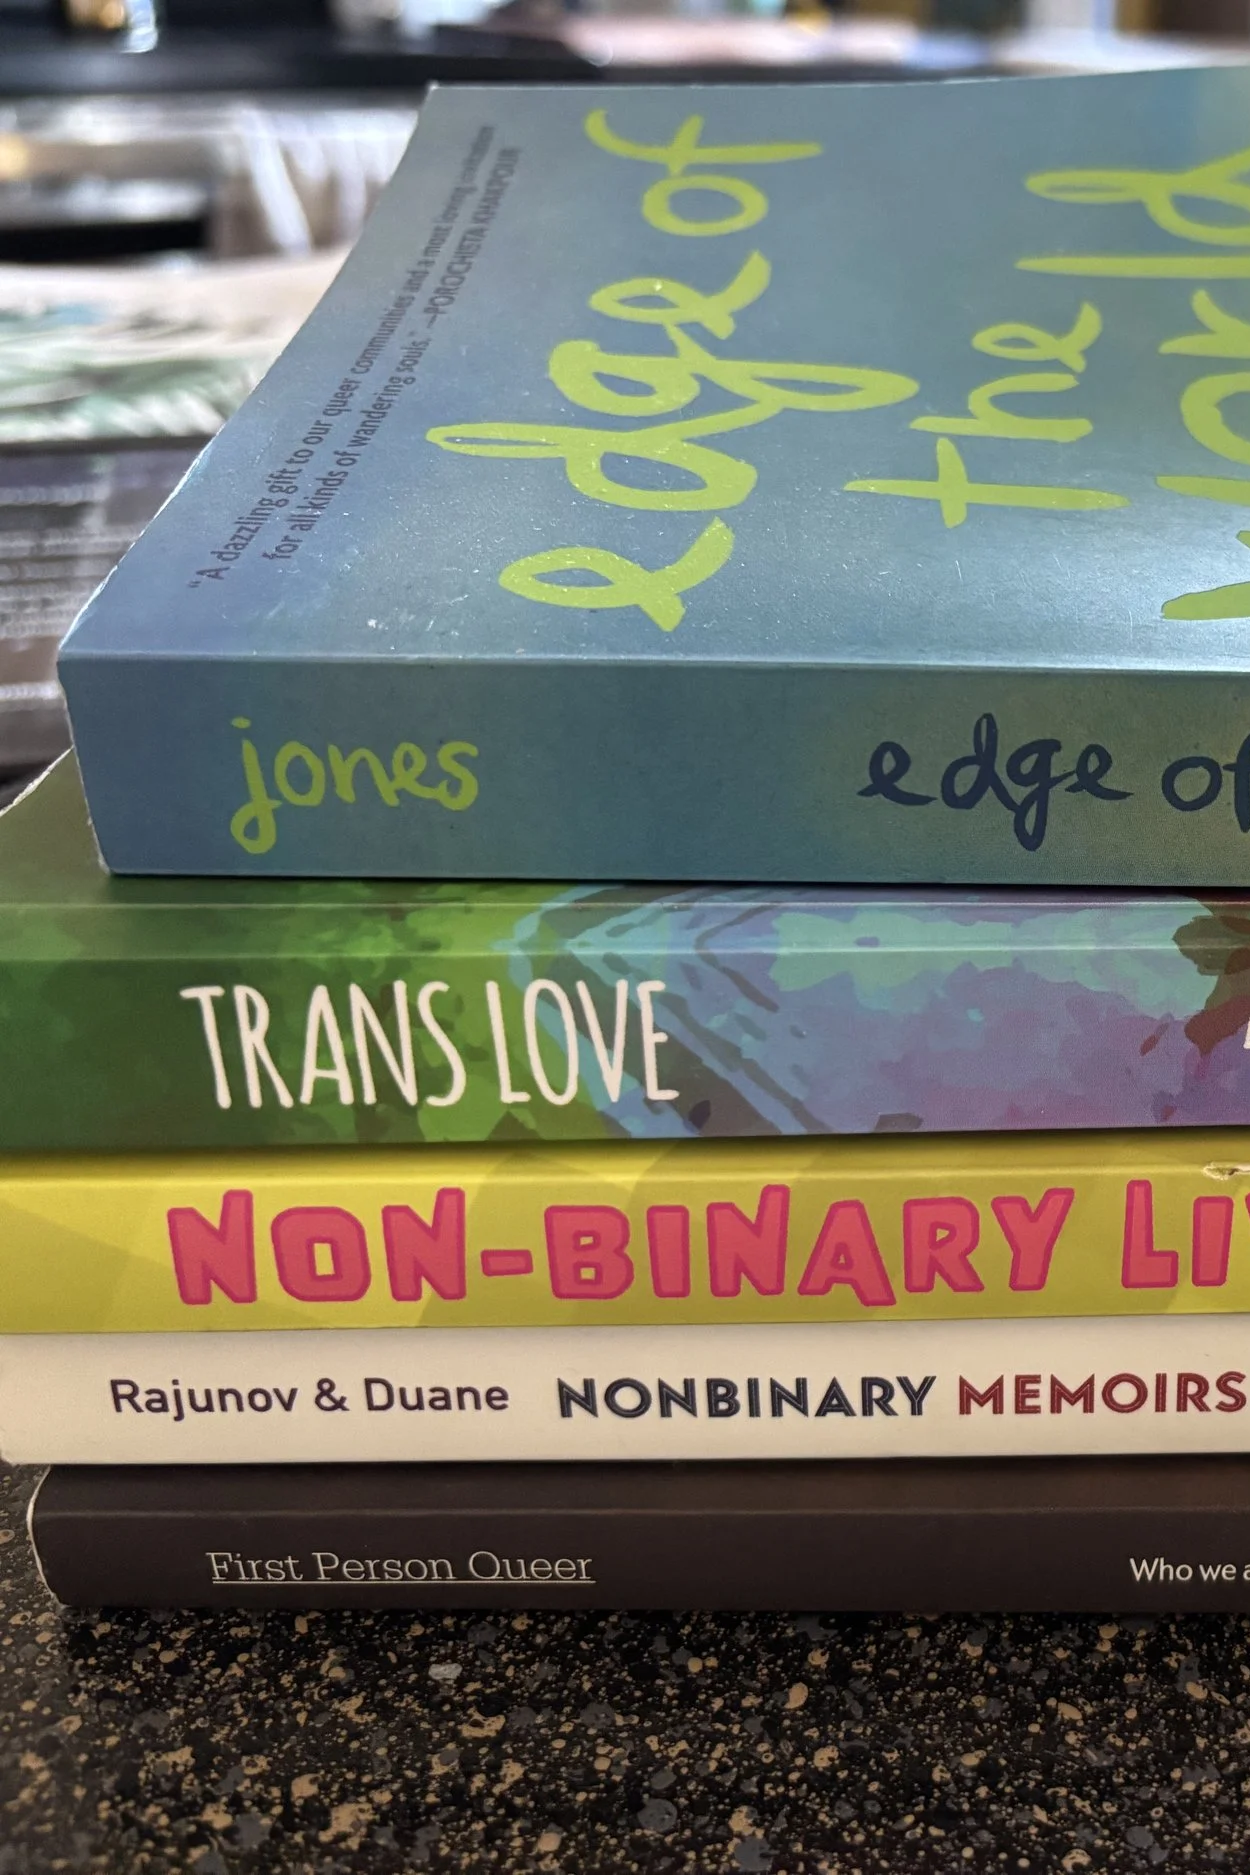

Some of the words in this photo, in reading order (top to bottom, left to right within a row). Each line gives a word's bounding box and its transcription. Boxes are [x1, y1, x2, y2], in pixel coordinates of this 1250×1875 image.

[584, 108, 824, 237] of
[210, 497, 290, 561] dazzling
[266, 467, 302, 495] gift
[286, 447, 314, 466] to
[303, 419, 333, 445] our
[322, 377, 361, 418] queer
[351, 295, 415, 375] communities
[405, 270, 430, 294] and
[347, 376, 416, 448] wandering
[426, 250, 920, 632] edge
[844, 301, 1132, 529] the
[296, 470, 348, 515] kinds
[334, 449, 361, 468] of
[262, 535, 303, 560] for
[290, 509, 320, 532] all
[229, 716, 480, 855] jones
[857, 712, 1134, 852] edge
[179, 979, 467, 1110] TRANS
[486, 978, 681, 1106] LOVE
[167, 1184, 1075, 1306] NON-BINARY
[109, 1377, 299, 1421] Rajunov
[314, 1377, 350, 1412] &
[364, 1377, 510, 1412] Duane
[557, 1375, 937, 1419] NONBINARY
[958, 1370, 1247, 1416] MEMOIRS
[206, 1551, 304, 1581] First
[312, 1552, 457, 1581] Person
[468, 1550, 593, 1581] Queer
[1129, 1556, 1193, 1582] Who
[1199, 1563, 1237, 1581] we
